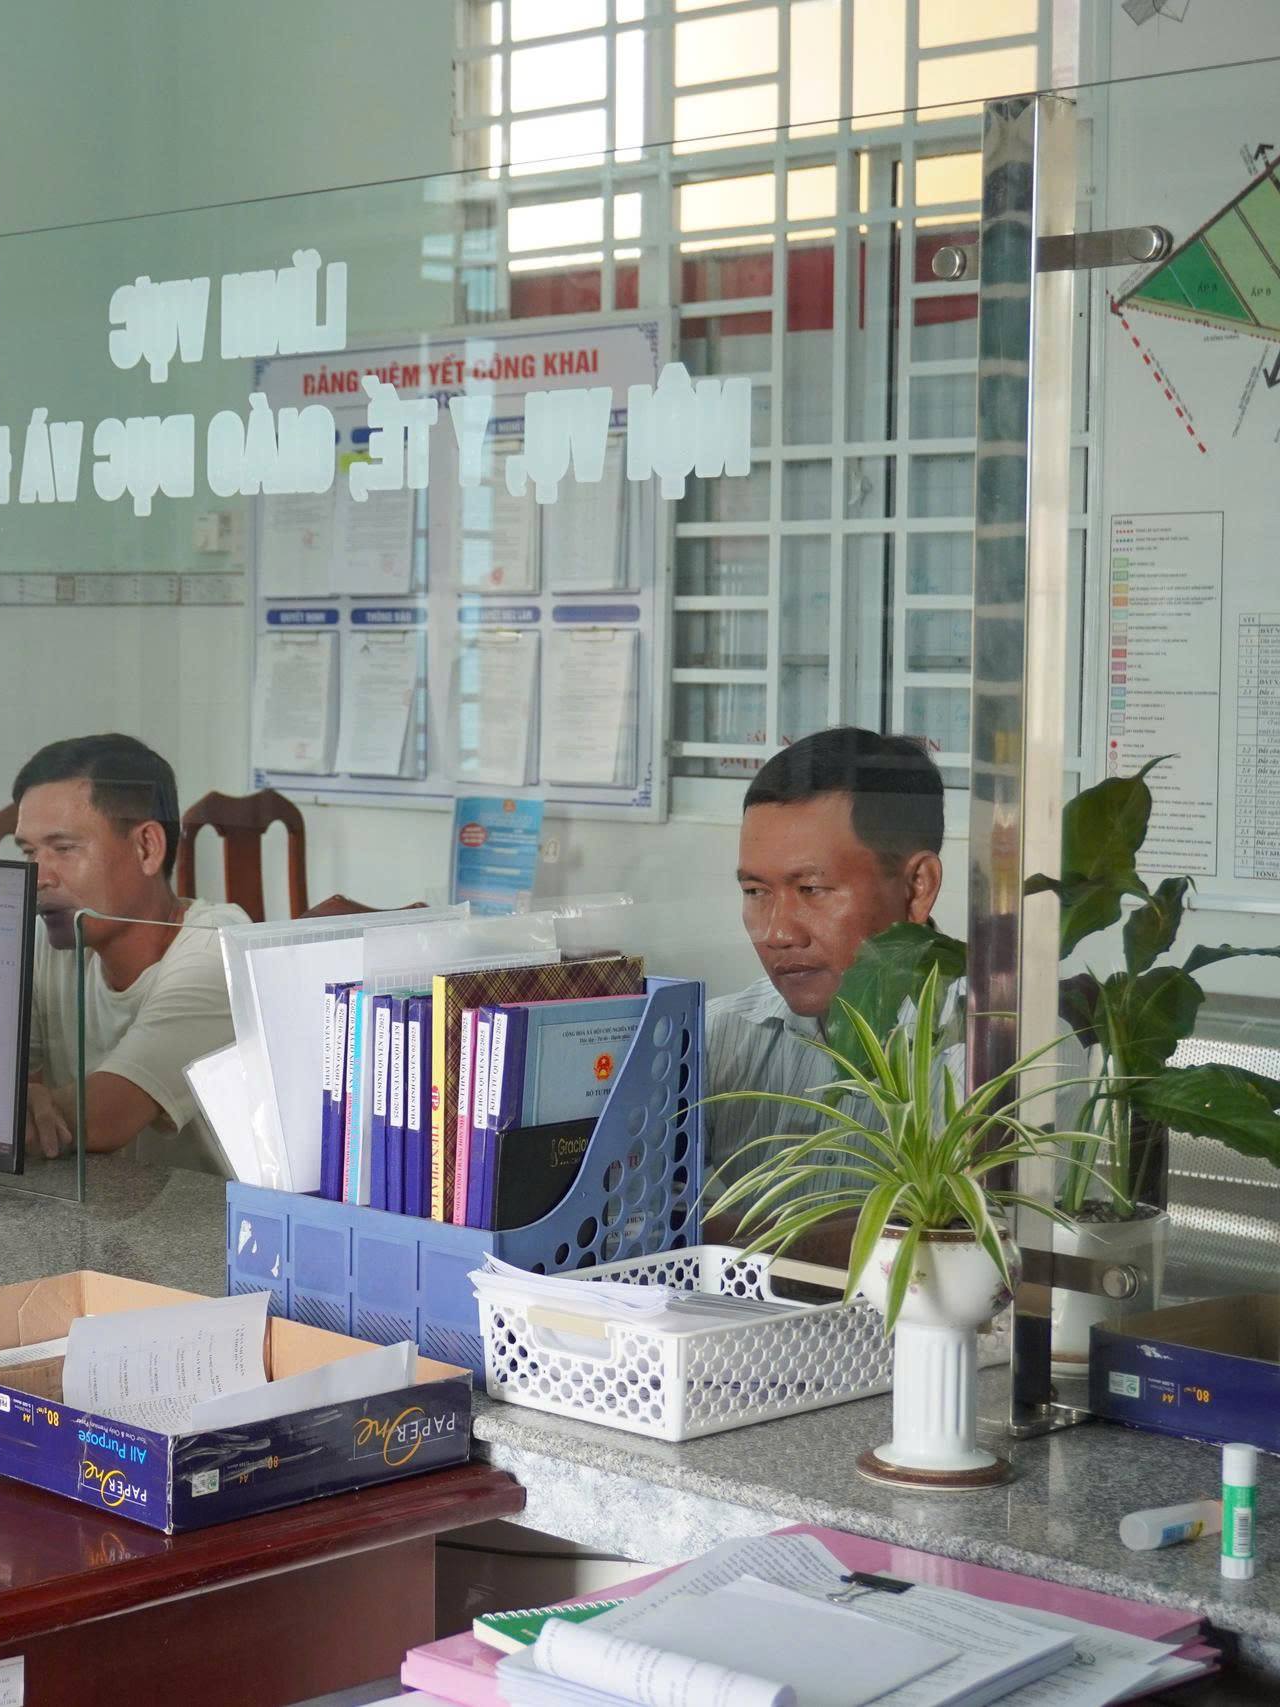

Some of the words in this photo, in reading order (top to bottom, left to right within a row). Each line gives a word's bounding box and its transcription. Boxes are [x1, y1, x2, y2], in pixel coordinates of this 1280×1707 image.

[303, 365, 359, 396] BẢNG
[427, 353, 466, 387] YẾT
[544, 349, 599, 377] KHAI
[77, 1430, 127, 1459] Purpose
[130, 1446, 147, 1465] All
